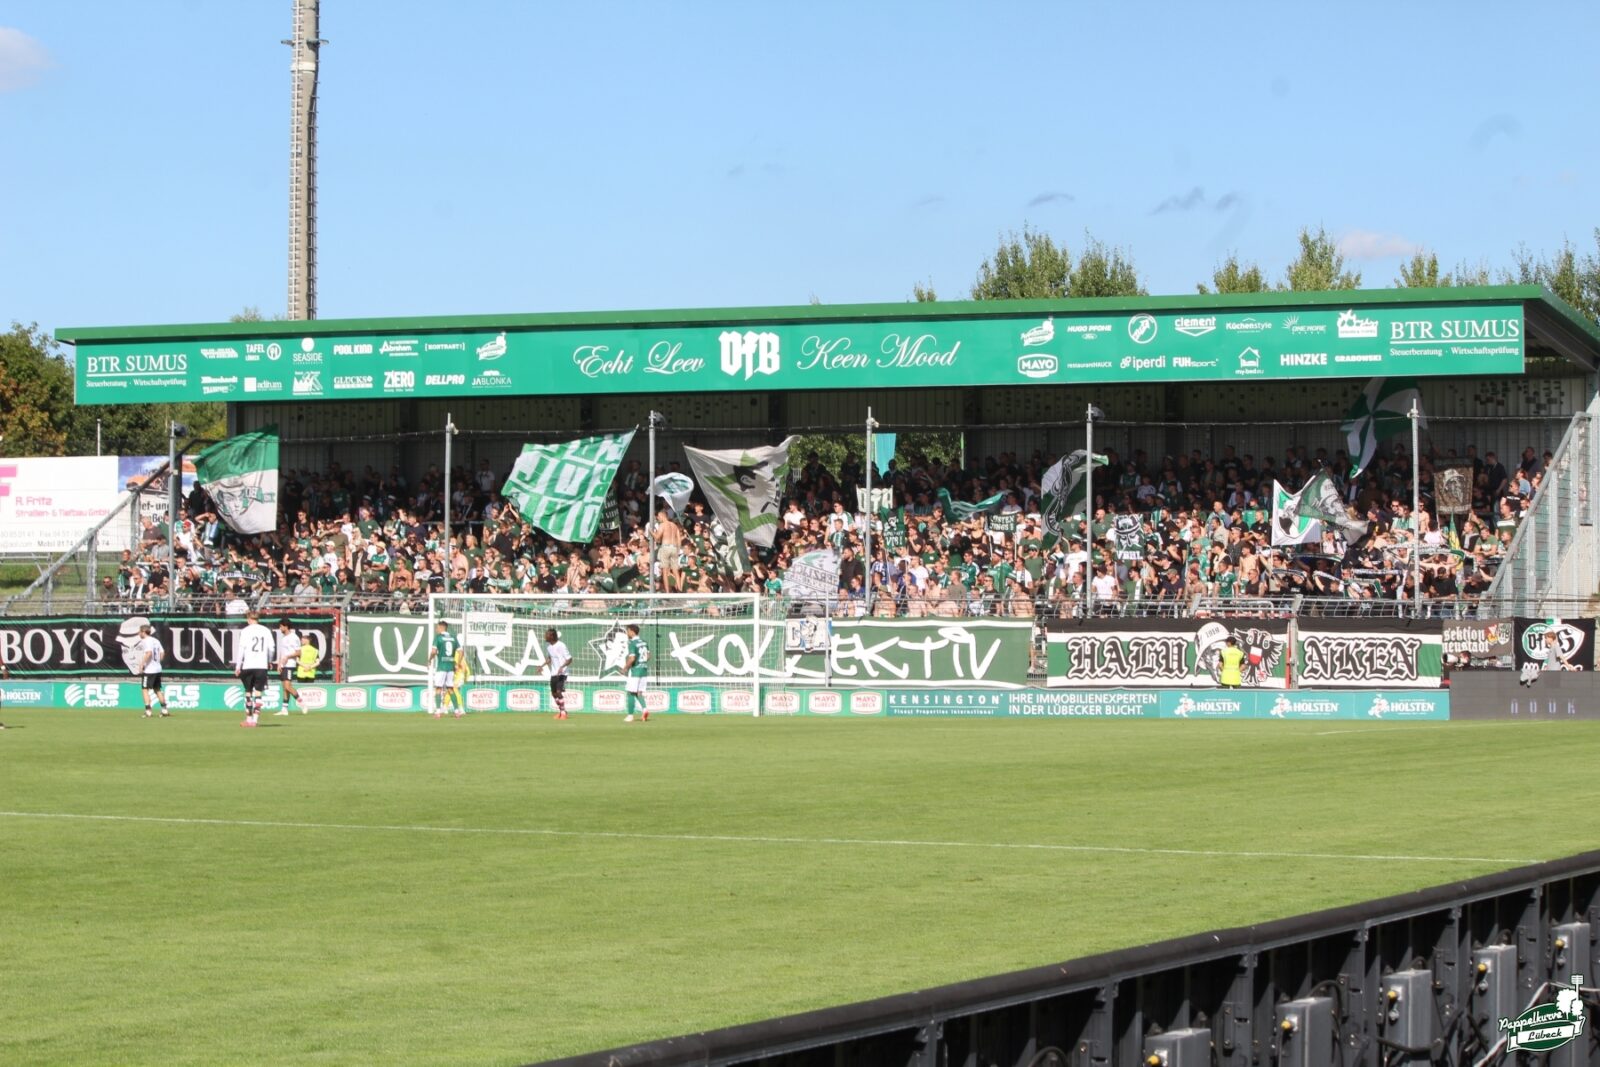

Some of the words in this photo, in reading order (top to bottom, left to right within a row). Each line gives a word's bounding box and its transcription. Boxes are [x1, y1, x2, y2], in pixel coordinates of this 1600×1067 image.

[1174, 316, 1216, 328] clement
[1390, 320, 1434, 339] BTR
[1440, 318, 1520, 338] SUMUS
[246, 343, 265, 353] TAFEL
[796, 335, 871, 370] Keen
[876, 333, 962, 368] Mood
[1389, 347, 1443, 357] Steuerberatung
[1450, 345, 1519, 356] Wirtschaftsprüfung
[293, 352, 323, 361] SEASIDE
[572, 345, 634, 378] Echt
[1280, 353, 1328, 366] HINZKE
[87, 356, 121, 373] BTR
[125, 354, 187, 372] SUMUS
[1021, 358, 1054, 370] MAYO
[425, 374, 465, 386] DELLPRO
[472, 376, 512, 387] JABLONKA
[1444, 626, 1486, 641] sektion
[1, 628, 104, 664] BOYS
[252, 636, 265, 653] 21
[6, 691, 41, 701] HOLSTEN
[84, 683, 119, 700] FLS
[165, 685, 200, 701] FLS
[84, 700, 119, 708] GROUP
[889, 694, 1000, 705] KENSINGTON
[1009, 694, 1033, 704] IHRE
[1036, 693, 1158, 704] IMMOBILIENEXPERTEN
[1008, 705, 1020, 715] IN
[1023, 705, 1044, 715] DER
[1047, 702, 1102, 715] LÜBECKER
[1105, 705, 1145, 715] BUCHT.
[1197, 702, 1241, 712] HOLSTEN
[1293, 702, 1338, 713] HOLSTEN
[1390, 702, 1434, 713] HOLSTEN
